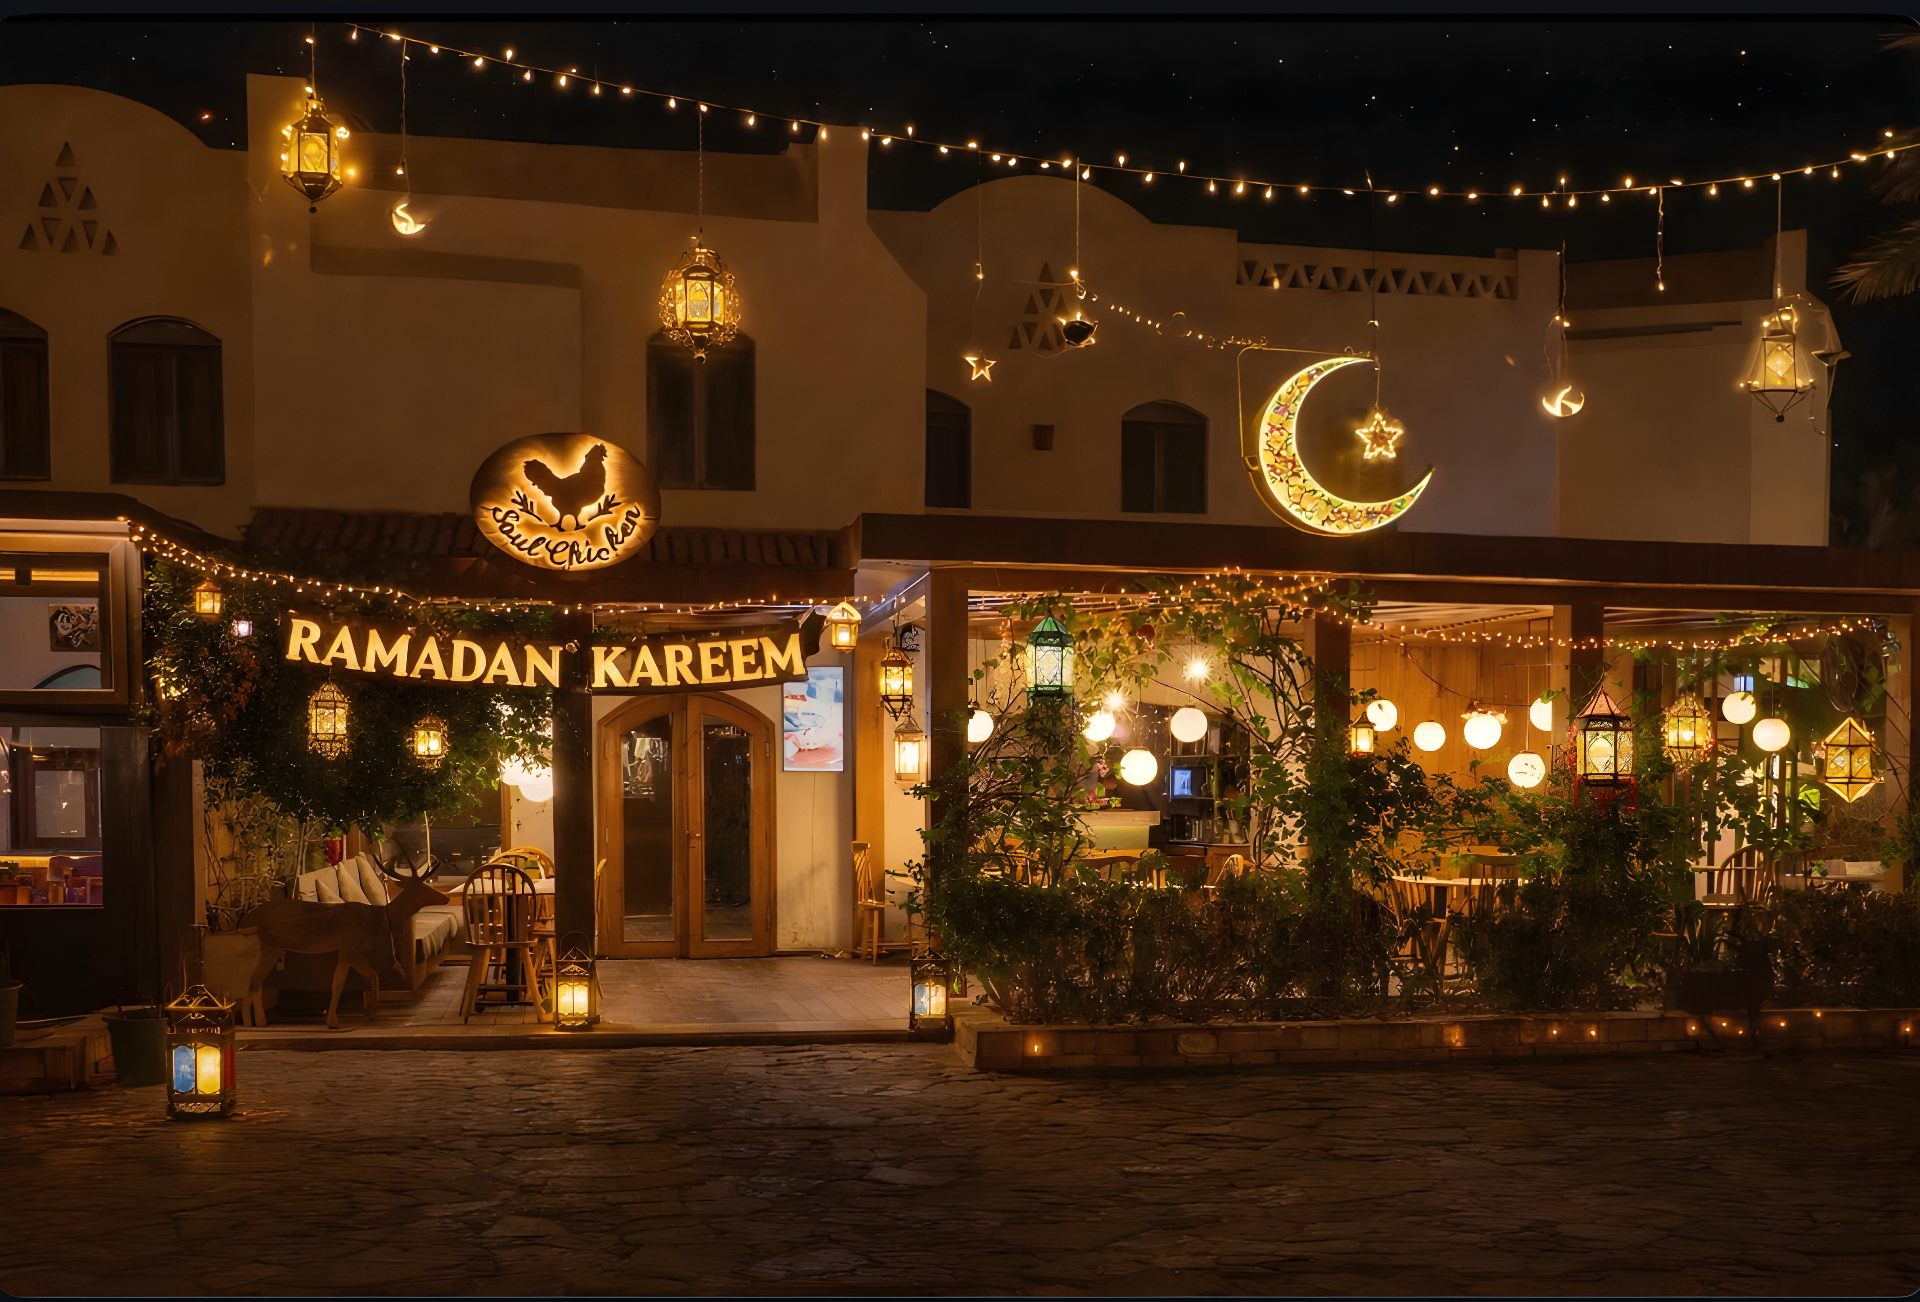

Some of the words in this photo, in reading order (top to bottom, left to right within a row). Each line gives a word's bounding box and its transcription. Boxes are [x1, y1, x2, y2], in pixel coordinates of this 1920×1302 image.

[483, 507, 547, 556] Soul
[545, 506, 640, 567] Chicken
[286, 618, 562, 688] RAMADAN
[592, 633, 806, 688] KAREEM
